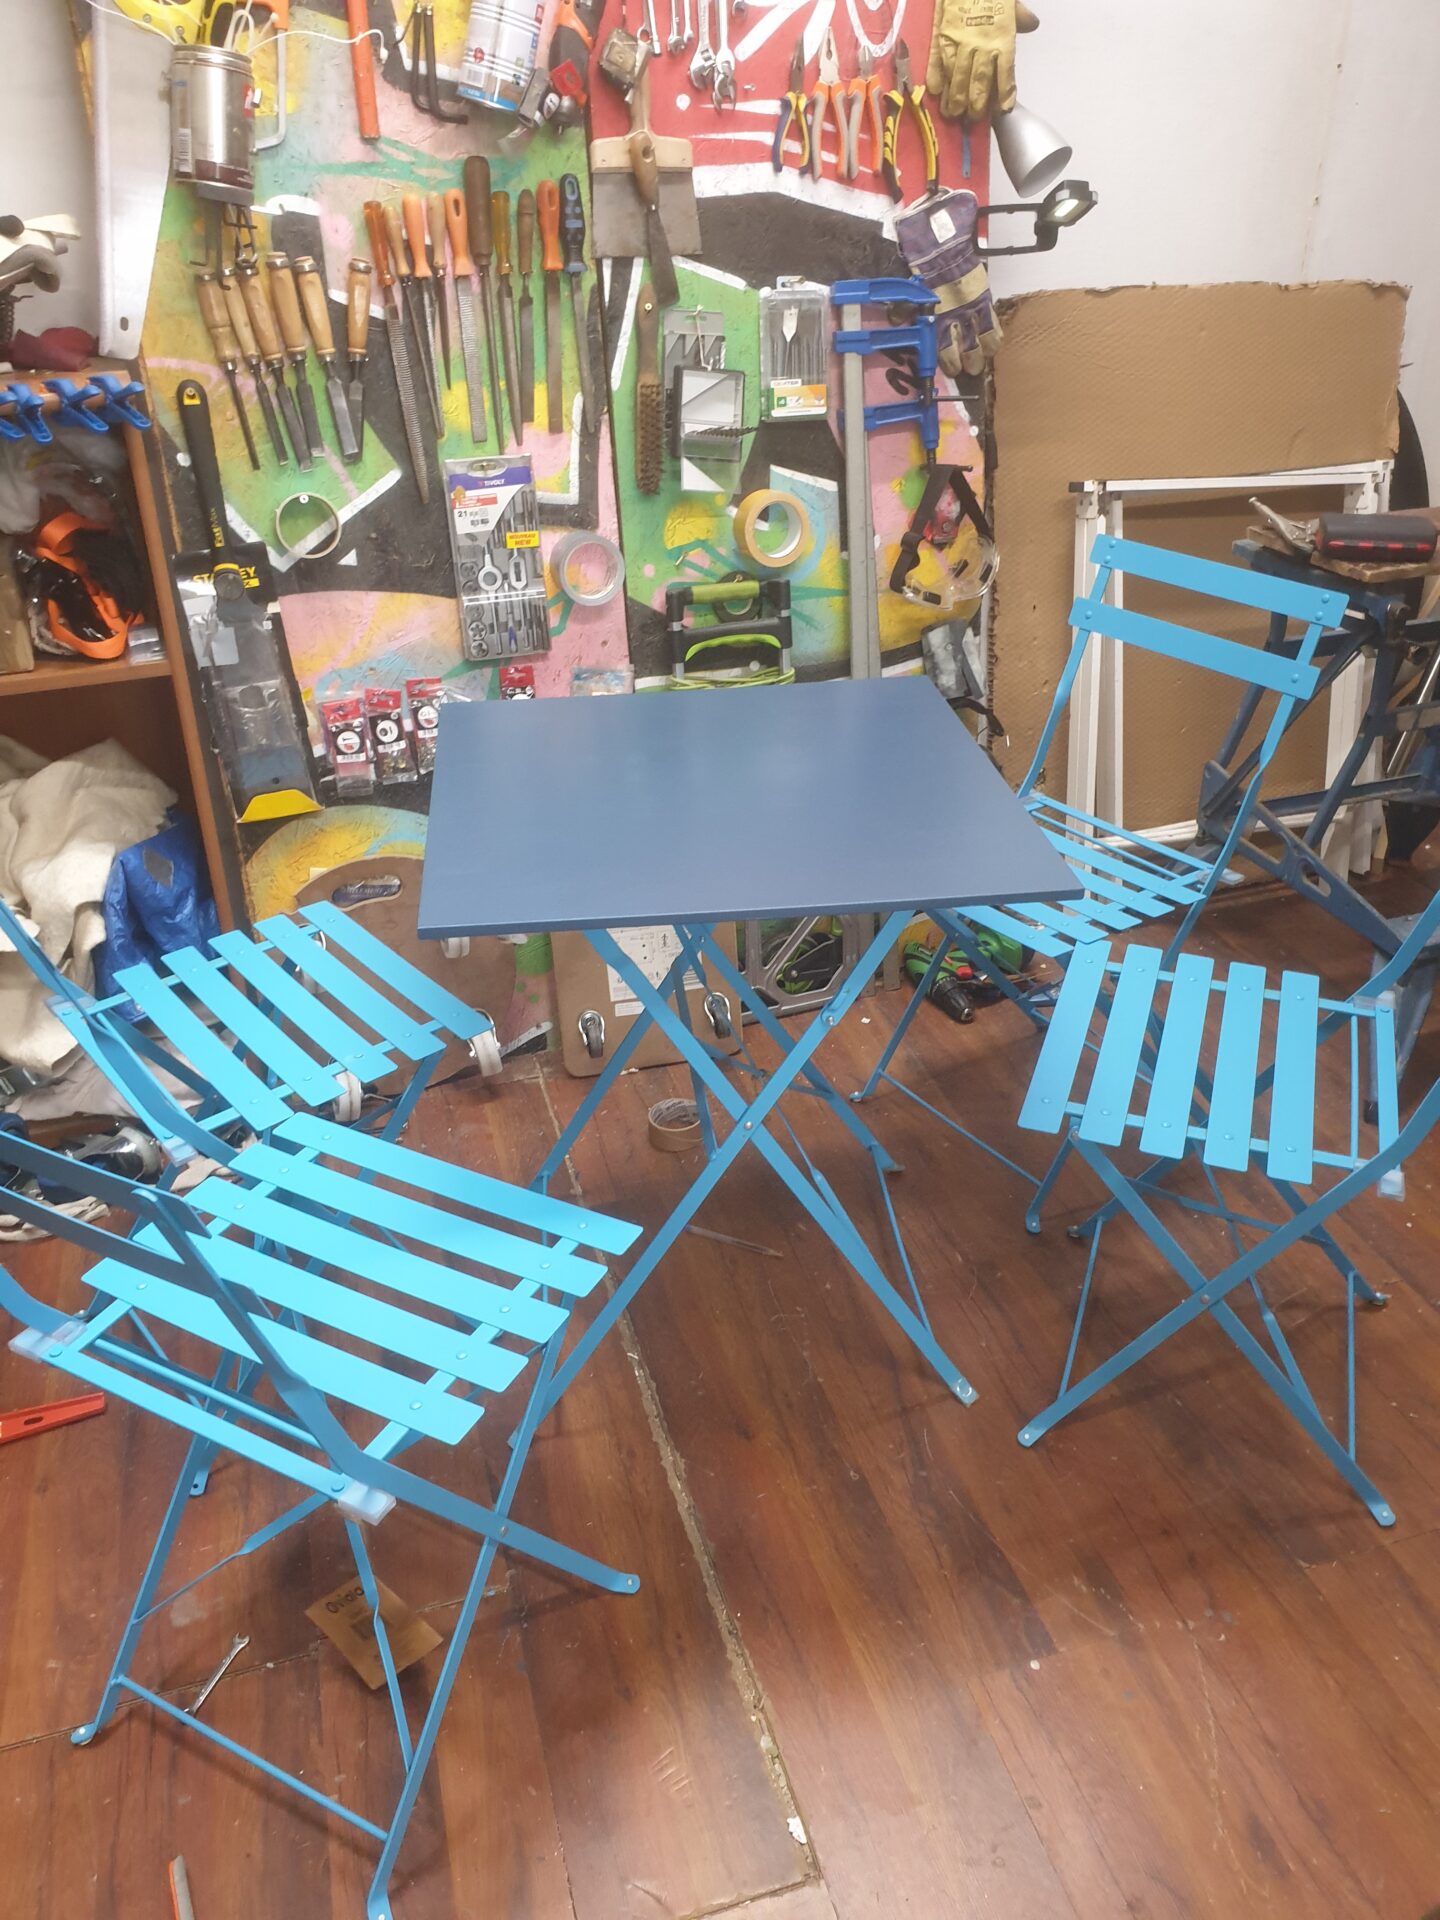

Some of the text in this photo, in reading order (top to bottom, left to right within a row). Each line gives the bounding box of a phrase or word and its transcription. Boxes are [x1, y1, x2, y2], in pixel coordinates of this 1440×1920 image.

[484, 479, 505, 487] TIVOLY
[457, 510, 468, 518] 21
[192, 566, 256, 584] STEY
